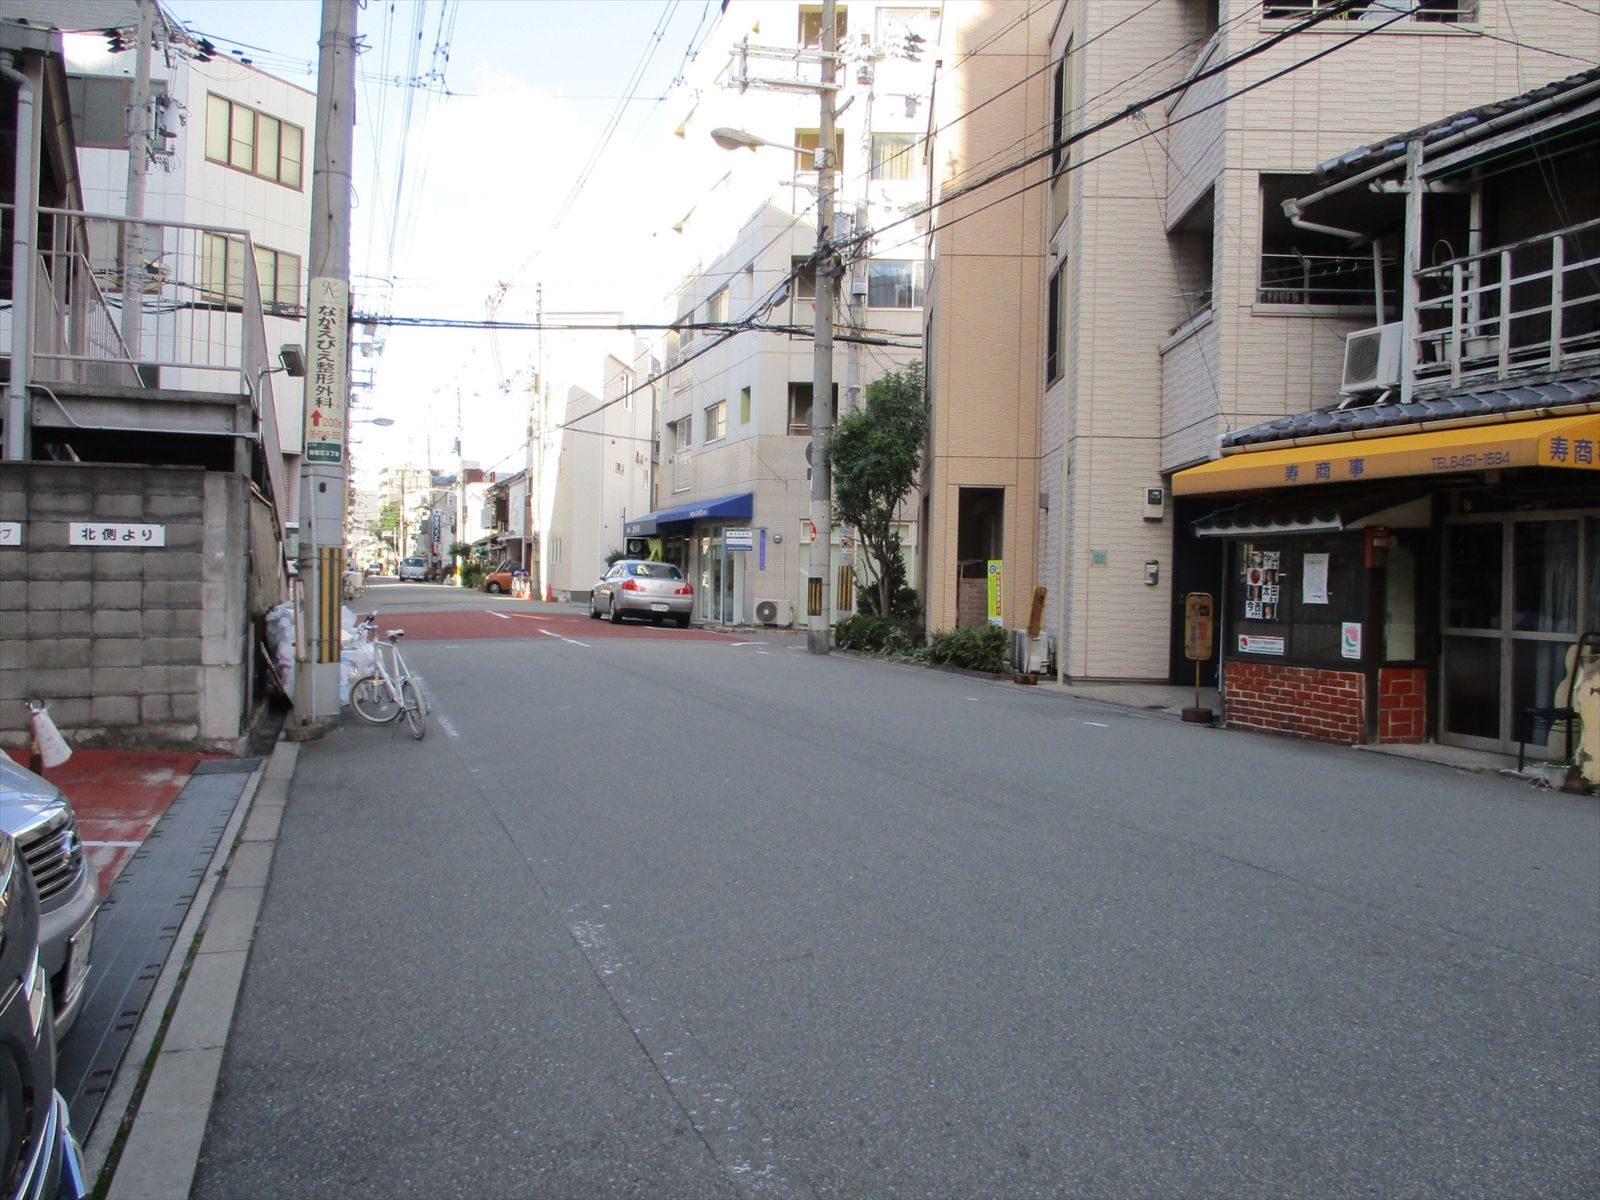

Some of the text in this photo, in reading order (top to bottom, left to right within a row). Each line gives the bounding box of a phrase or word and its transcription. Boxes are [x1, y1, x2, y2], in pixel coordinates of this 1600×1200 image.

[1549, 436, 1600, 464] 寿商
[1285, 458, 1365, 481] 寿商事
[82, 528, 152, 541] 北側より
